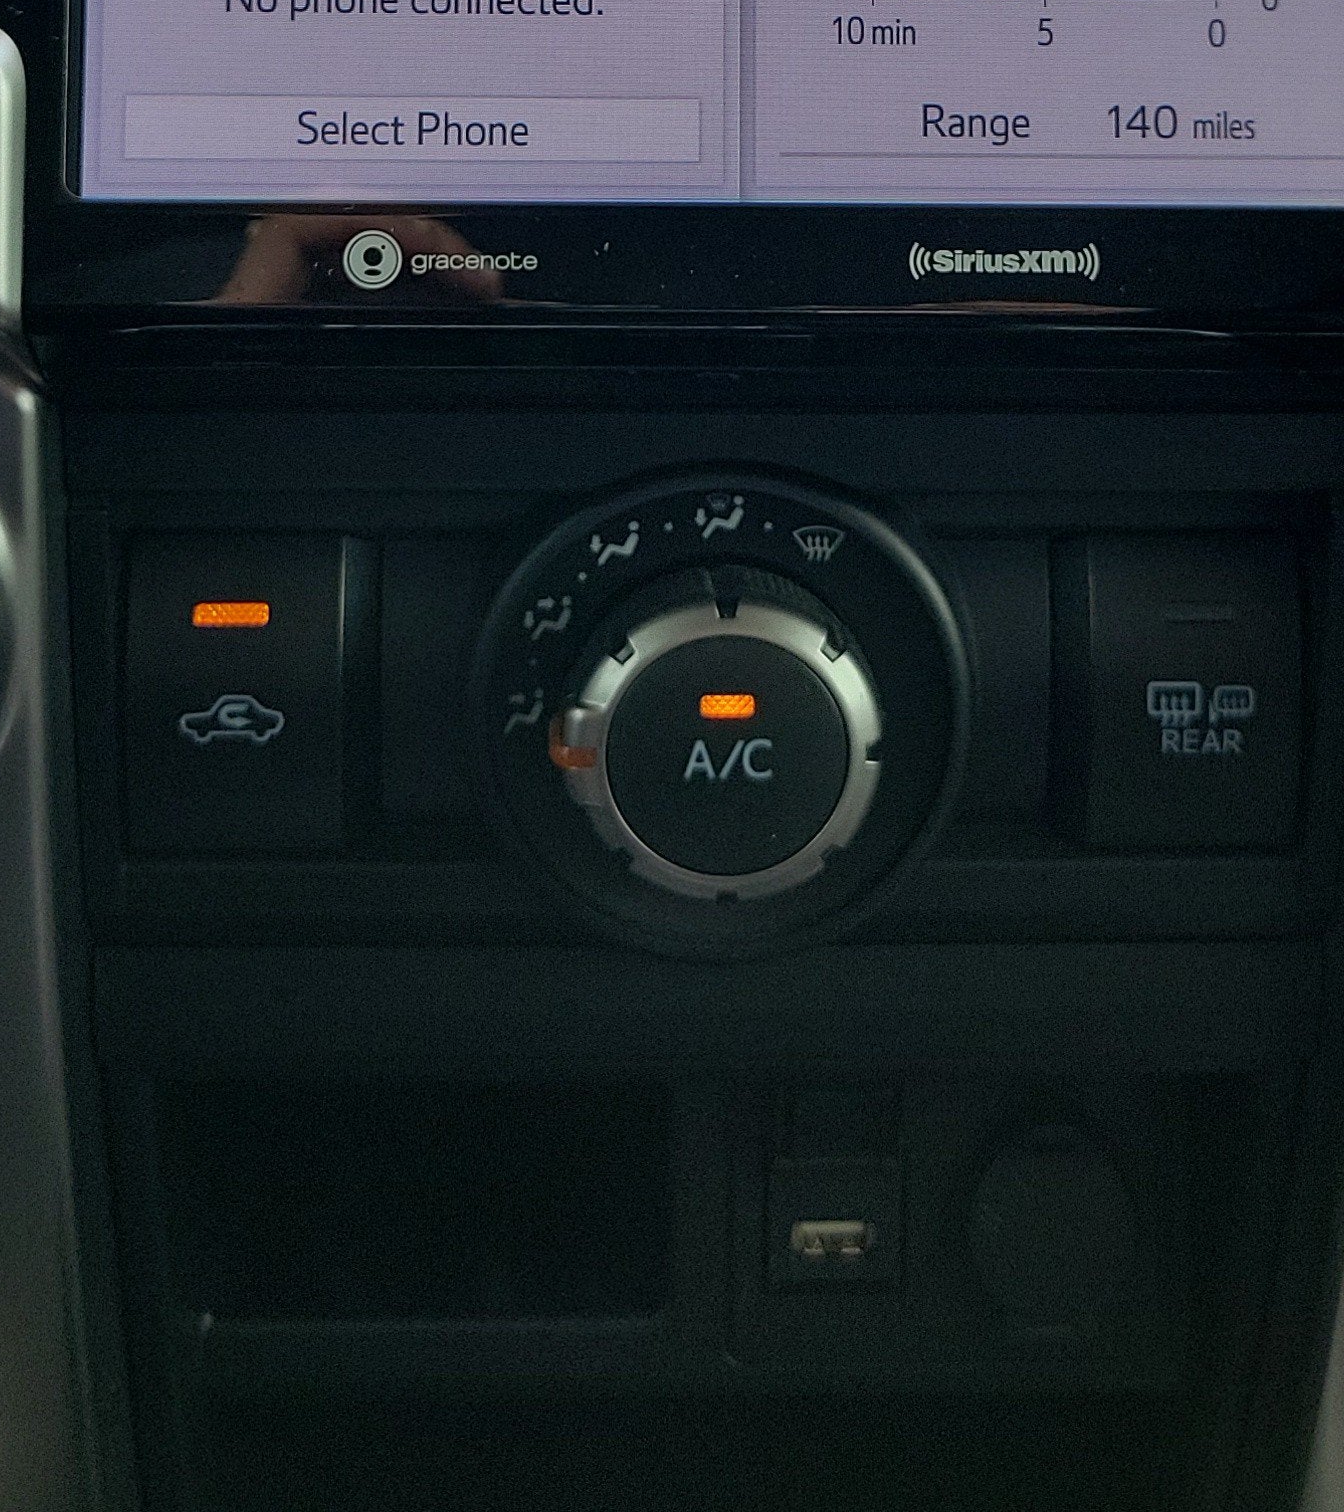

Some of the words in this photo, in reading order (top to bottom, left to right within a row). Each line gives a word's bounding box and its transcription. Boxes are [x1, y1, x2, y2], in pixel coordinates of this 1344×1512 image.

[833, 17, 865, 45] 10
[872, 19, 916, 45] min
[1037, 19, 1053, 46] 5
[1208, 19, 1226, 47] 0
[297, 110, 405, 146] Select
[417, 112, 529, 146] Phone
[922, 104, 1030, 146] Range
[1107, 105, 1177, 139] 140
[1193, 112, 1255, 140] miles
[411, 252, 538, 274] gracenote
[1161, 729, 1243, 754] REAR
[685, 739, 772, 780] A/C
